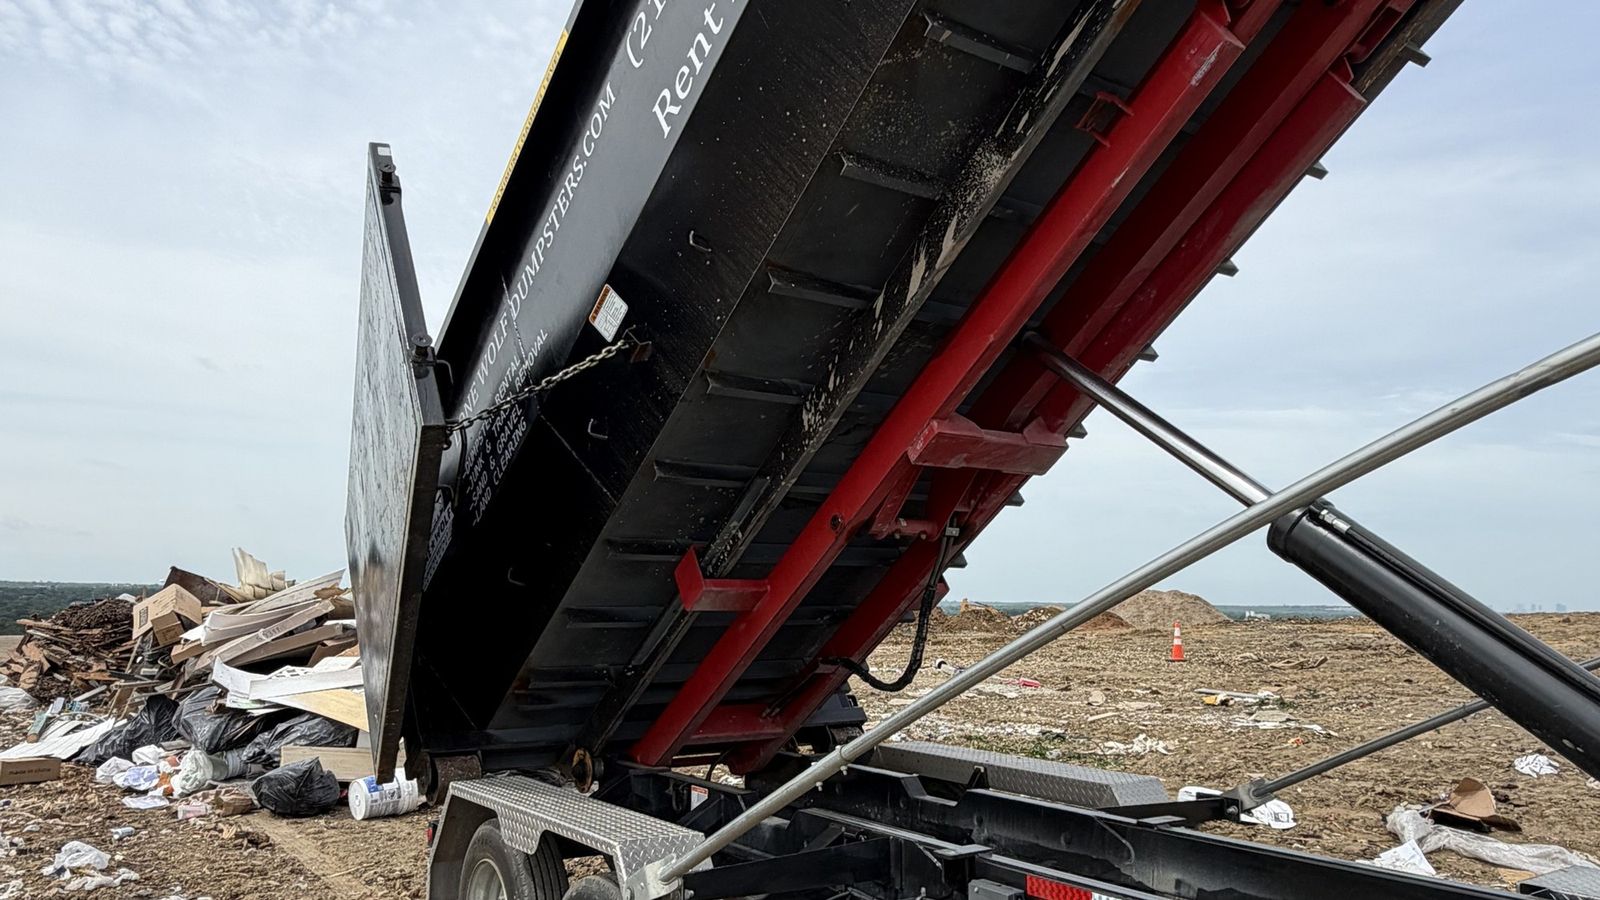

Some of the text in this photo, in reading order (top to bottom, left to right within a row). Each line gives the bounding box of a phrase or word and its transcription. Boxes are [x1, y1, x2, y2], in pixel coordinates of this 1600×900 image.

[652, 3, 723, 139] Rent
[477, 312, 509, 385] WOLF
[509, 81, 616, 320] DUMPSTERS.COM
[485, 439, 491, 453] &
[492, 391, 516, 437] TRA
[515, 329, 548, 392] REMOVAL
[495, 354, 522, 405] RENTAL
[489, 455, 495, 470] &
[497, 404, 522, 454] GRAVEL
[493, 416, 526, 486] CLEARING
